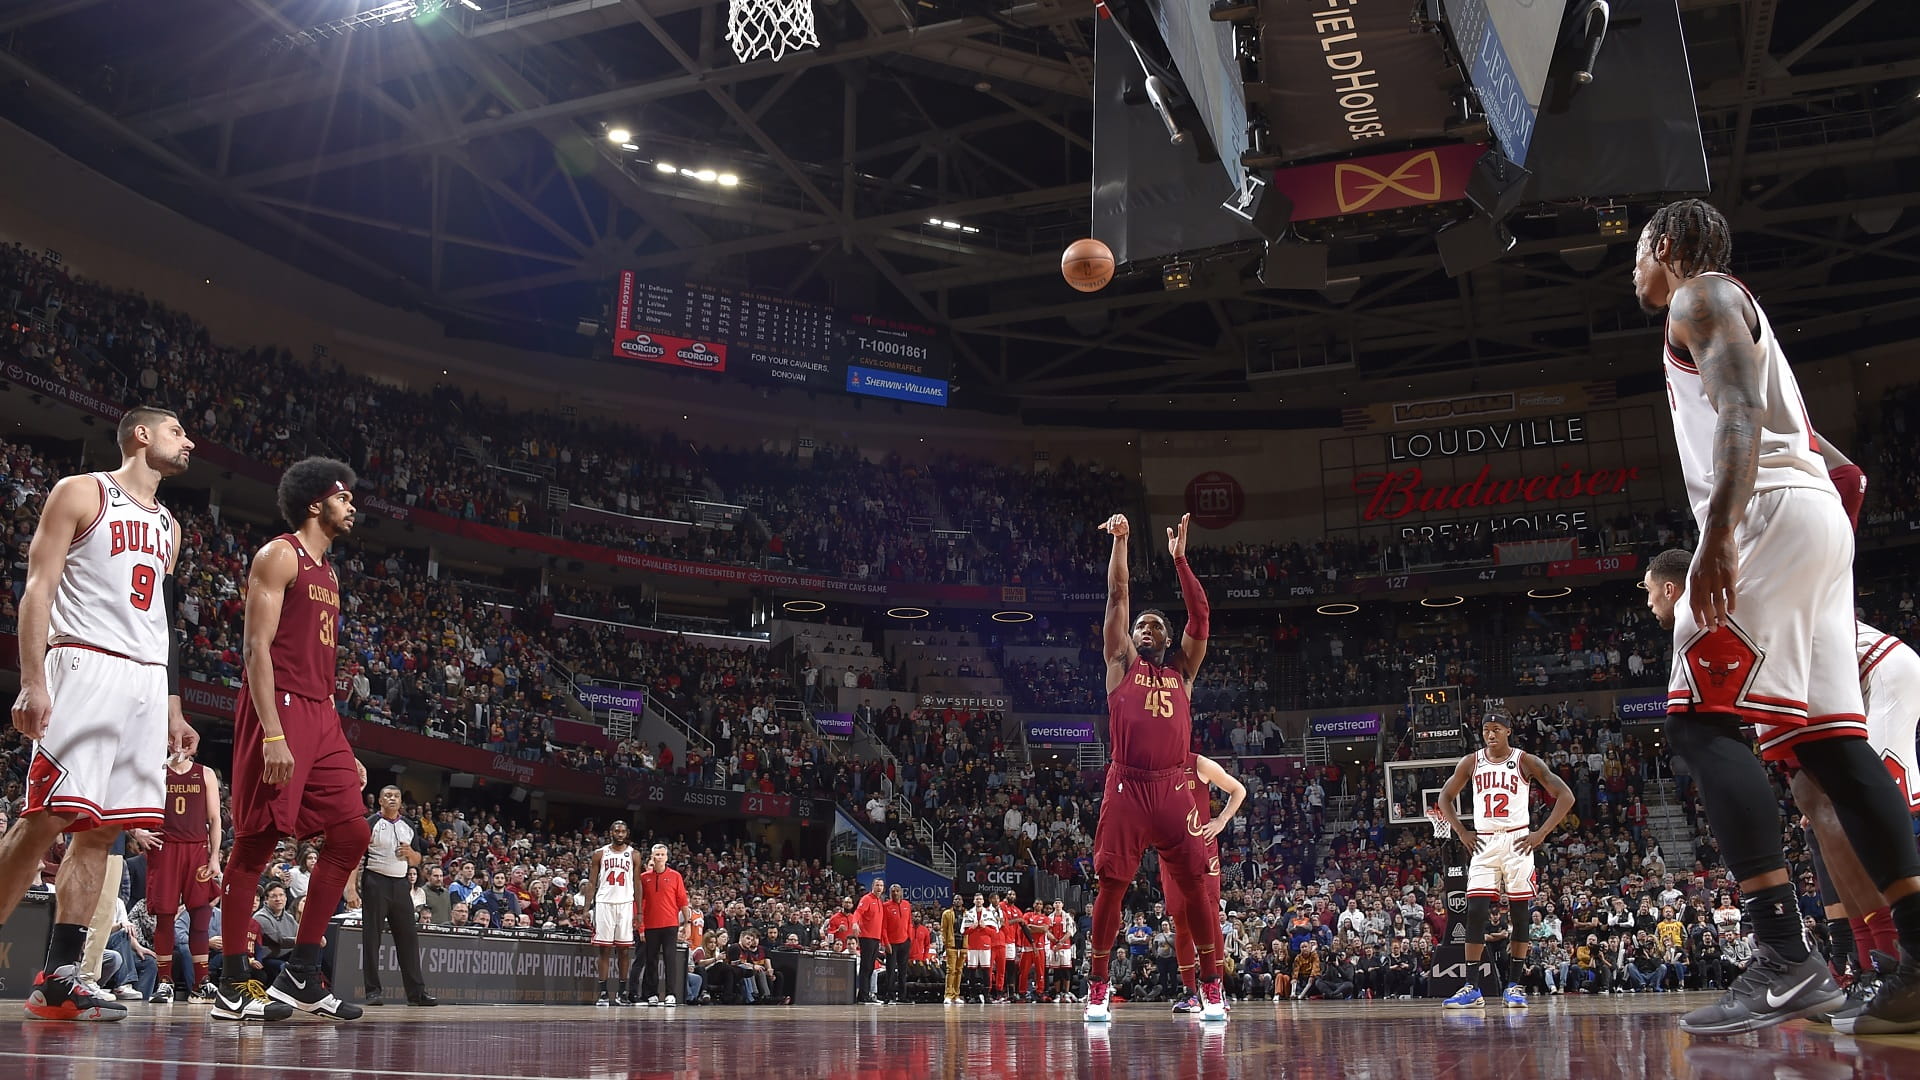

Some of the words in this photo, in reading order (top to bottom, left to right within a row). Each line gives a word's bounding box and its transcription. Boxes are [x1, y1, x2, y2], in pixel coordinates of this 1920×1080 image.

[622, 272, 632, 304] CHICAGO
[621, 342, 664, 355] GEORGIO'S
[858, 337, 928, 360] T-10001861
[677, 350, 720, 364] GEORGIO'S
[751, 353, 768, 363] FOR
[768, 356, 788, 366] YOUR
[771, 370, 806, 382] DONOVAN
[25, 371, 67, 398] TOYOTA
[69, 390, 99, 411] BEFORE
[99, 402, 124, 419] EVERY
[1391, 418, 1584, 460] LOUDVILLE
[1351, 462, 1640, 522] Budweiser
[1595, 558, 1620, 570] 130
[616, 554, 640, 566] WATCH
[641, 559, 678, 572] CAVALIERS
[679, 565, 695, 574] LIVE
[695, 567, 735, 578] PRESENTED
[736, 571, 746, 580] BY
[763, 574, 799, 585] TOYOTA
[800, 578, 826, 588] BEFORE
[827, 580, 848, 590] EVERY
[849, 583, 866, 592] CAVS
[867, 585, 887, 593] GAME
[1478, 571, 1496, 581] 4.7
[129, 563, 156, 612] 9
[1386, 577, 1409, 589] 127
[1227, 589, 1261, 598] FOULS
[1290, 585, 1314, 596] FG%
[319, 609, 335, 648] 31
[184, 687, 238, 711] WEDNES
[579, 692, 639, 708] everstream
[936, 697, 1004, 708] WESTFIELD
[1144, 689, 1174, 718] 45
[1425, 691, 1446, 704] 4.7
[1623, 700, 1668, 713] everstre
[1031, 726, 1090, 737] everstream
[1315, 719, 1376, 732] everstream
[1428, 729, 1460, 739] TISSOT
[166, 784, 201, 794] LEVELAND
[605, 784, 616, 796] 52
[1475, 771, 1519, 795] BULLS
[175, 796, 186, 815] 0
[648, 786, 664, 801] 26
[683, 792, 727, 806] ASSISTS
[749, 797, 763, 812] 21
[1483, 793, 1509, 818] 12
[799, 807, 810, 817] 53
[604, 857, 630, 872] BULLS
[606, 870, 626, 887] 44
[966, 870, 1023, 884] ROCKET
[901, 886, 949, 900] ECOM
[1450, 898, 1466, 910] ups
[357, 943, 386, 971] TE
[389, 946, 426, 972] OY
[429, 947, 514, 976] SPORTSBOOK
[516, 953, 540, 976] APP
[543, 954, 571, 977] WITH
[573, 956, 620, 979] CAESRS
